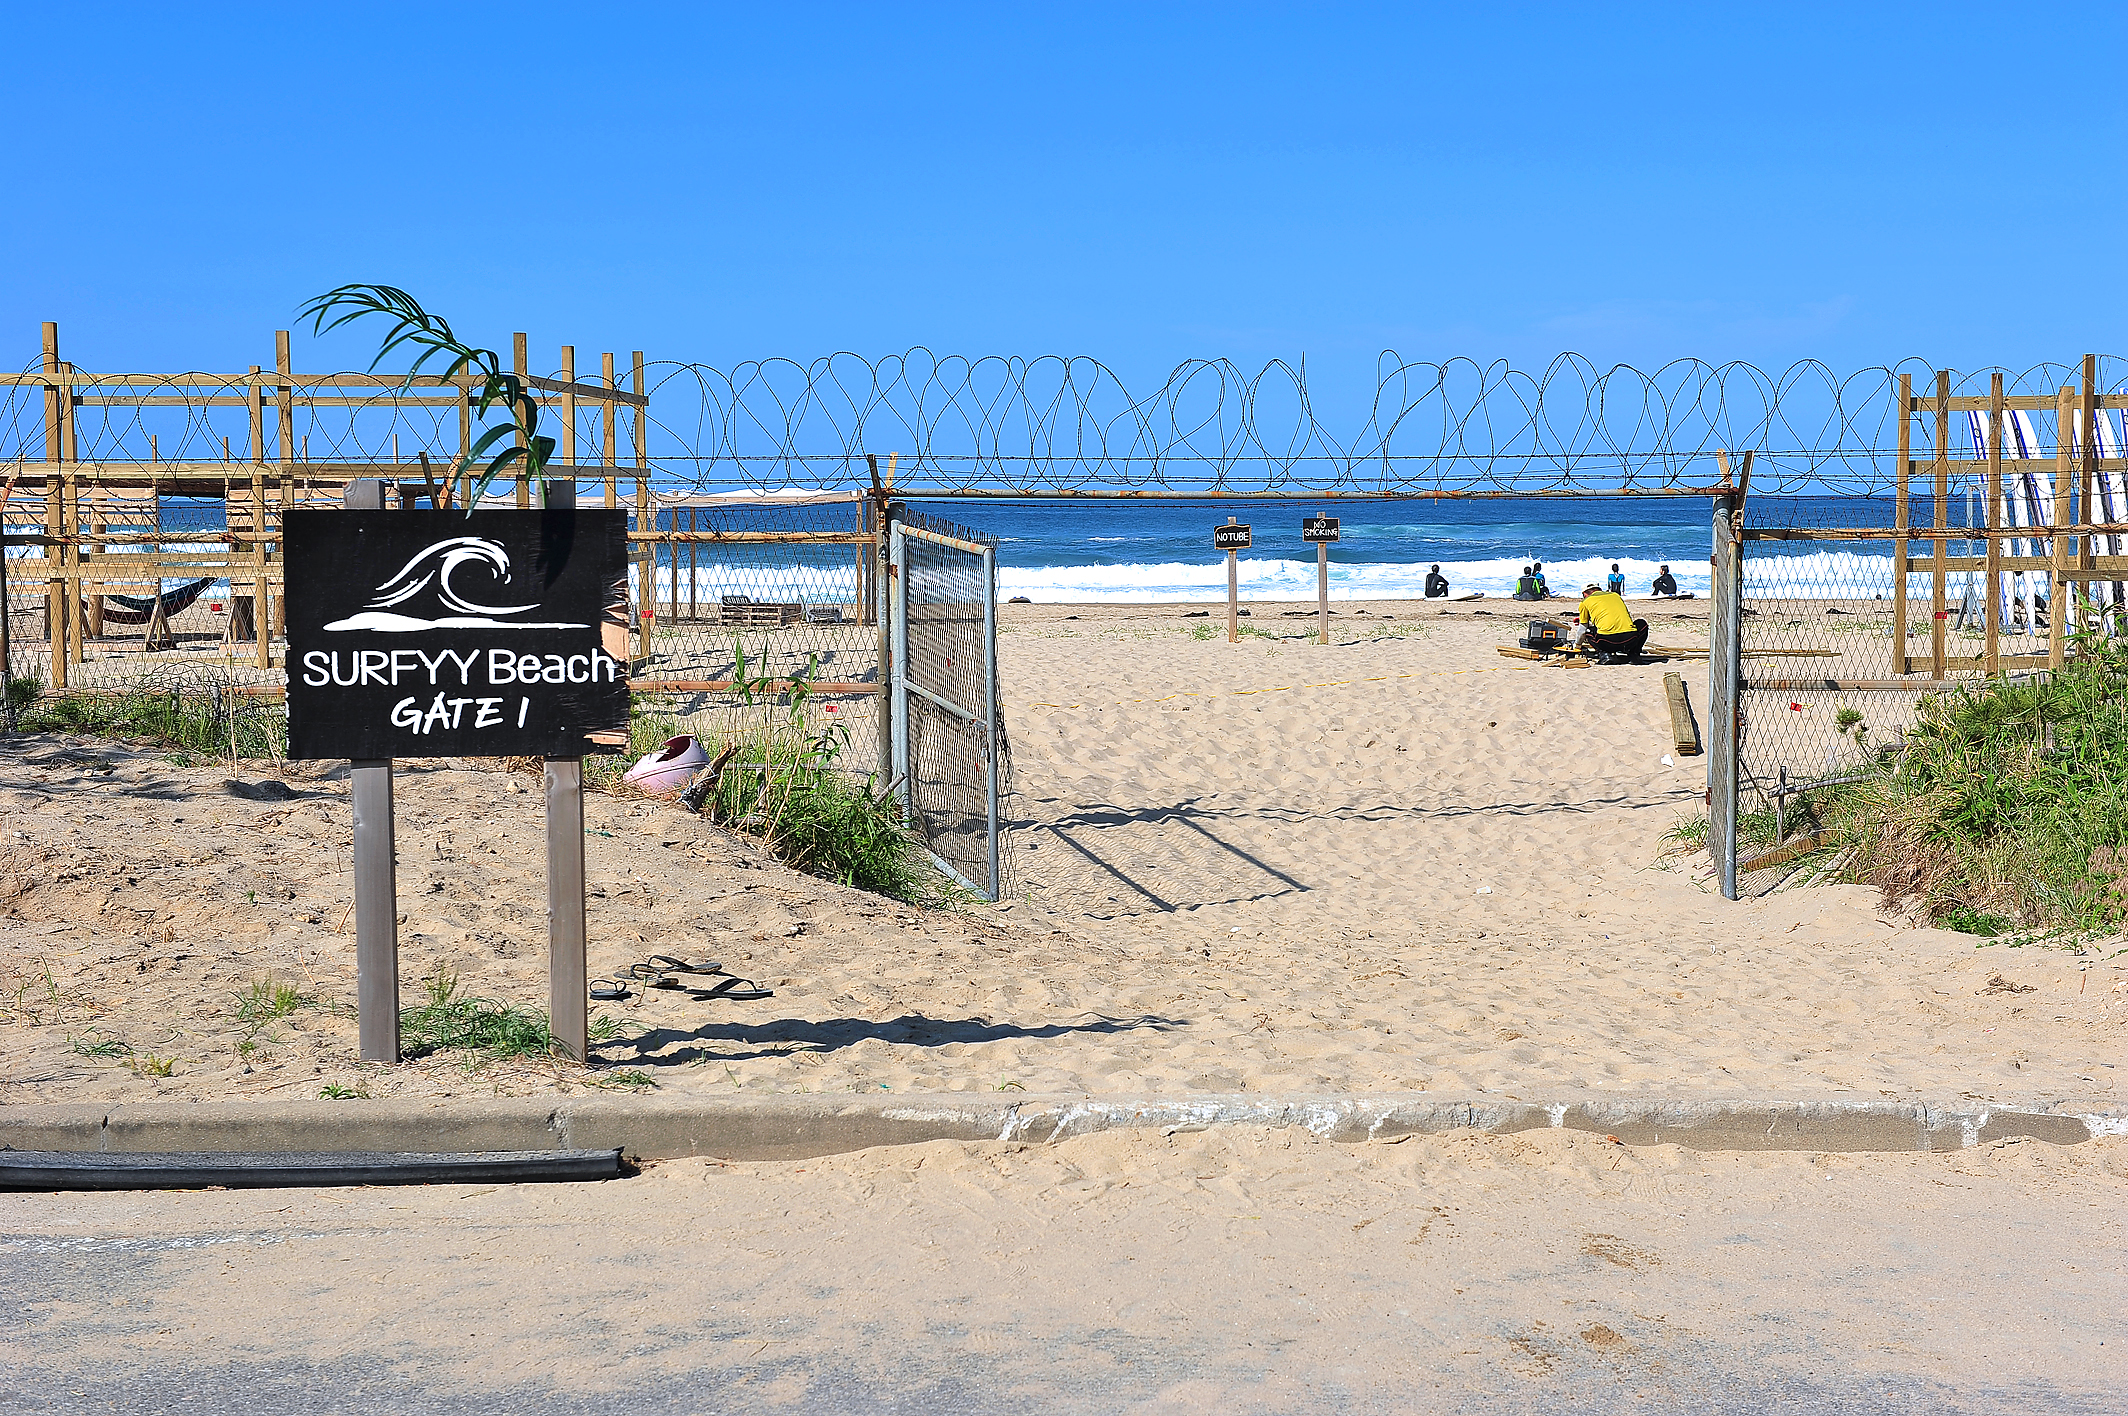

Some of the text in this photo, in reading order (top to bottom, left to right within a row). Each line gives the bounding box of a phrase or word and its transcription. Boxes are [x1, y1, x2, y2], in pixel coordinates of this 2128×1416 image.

[1304, 528, 1338, 537] SMOKING
[1313, 520, 1327, 529] NO
[302, 647, 616, 687] SURFYY Beach
[390, 691, 504, 735] GATE
